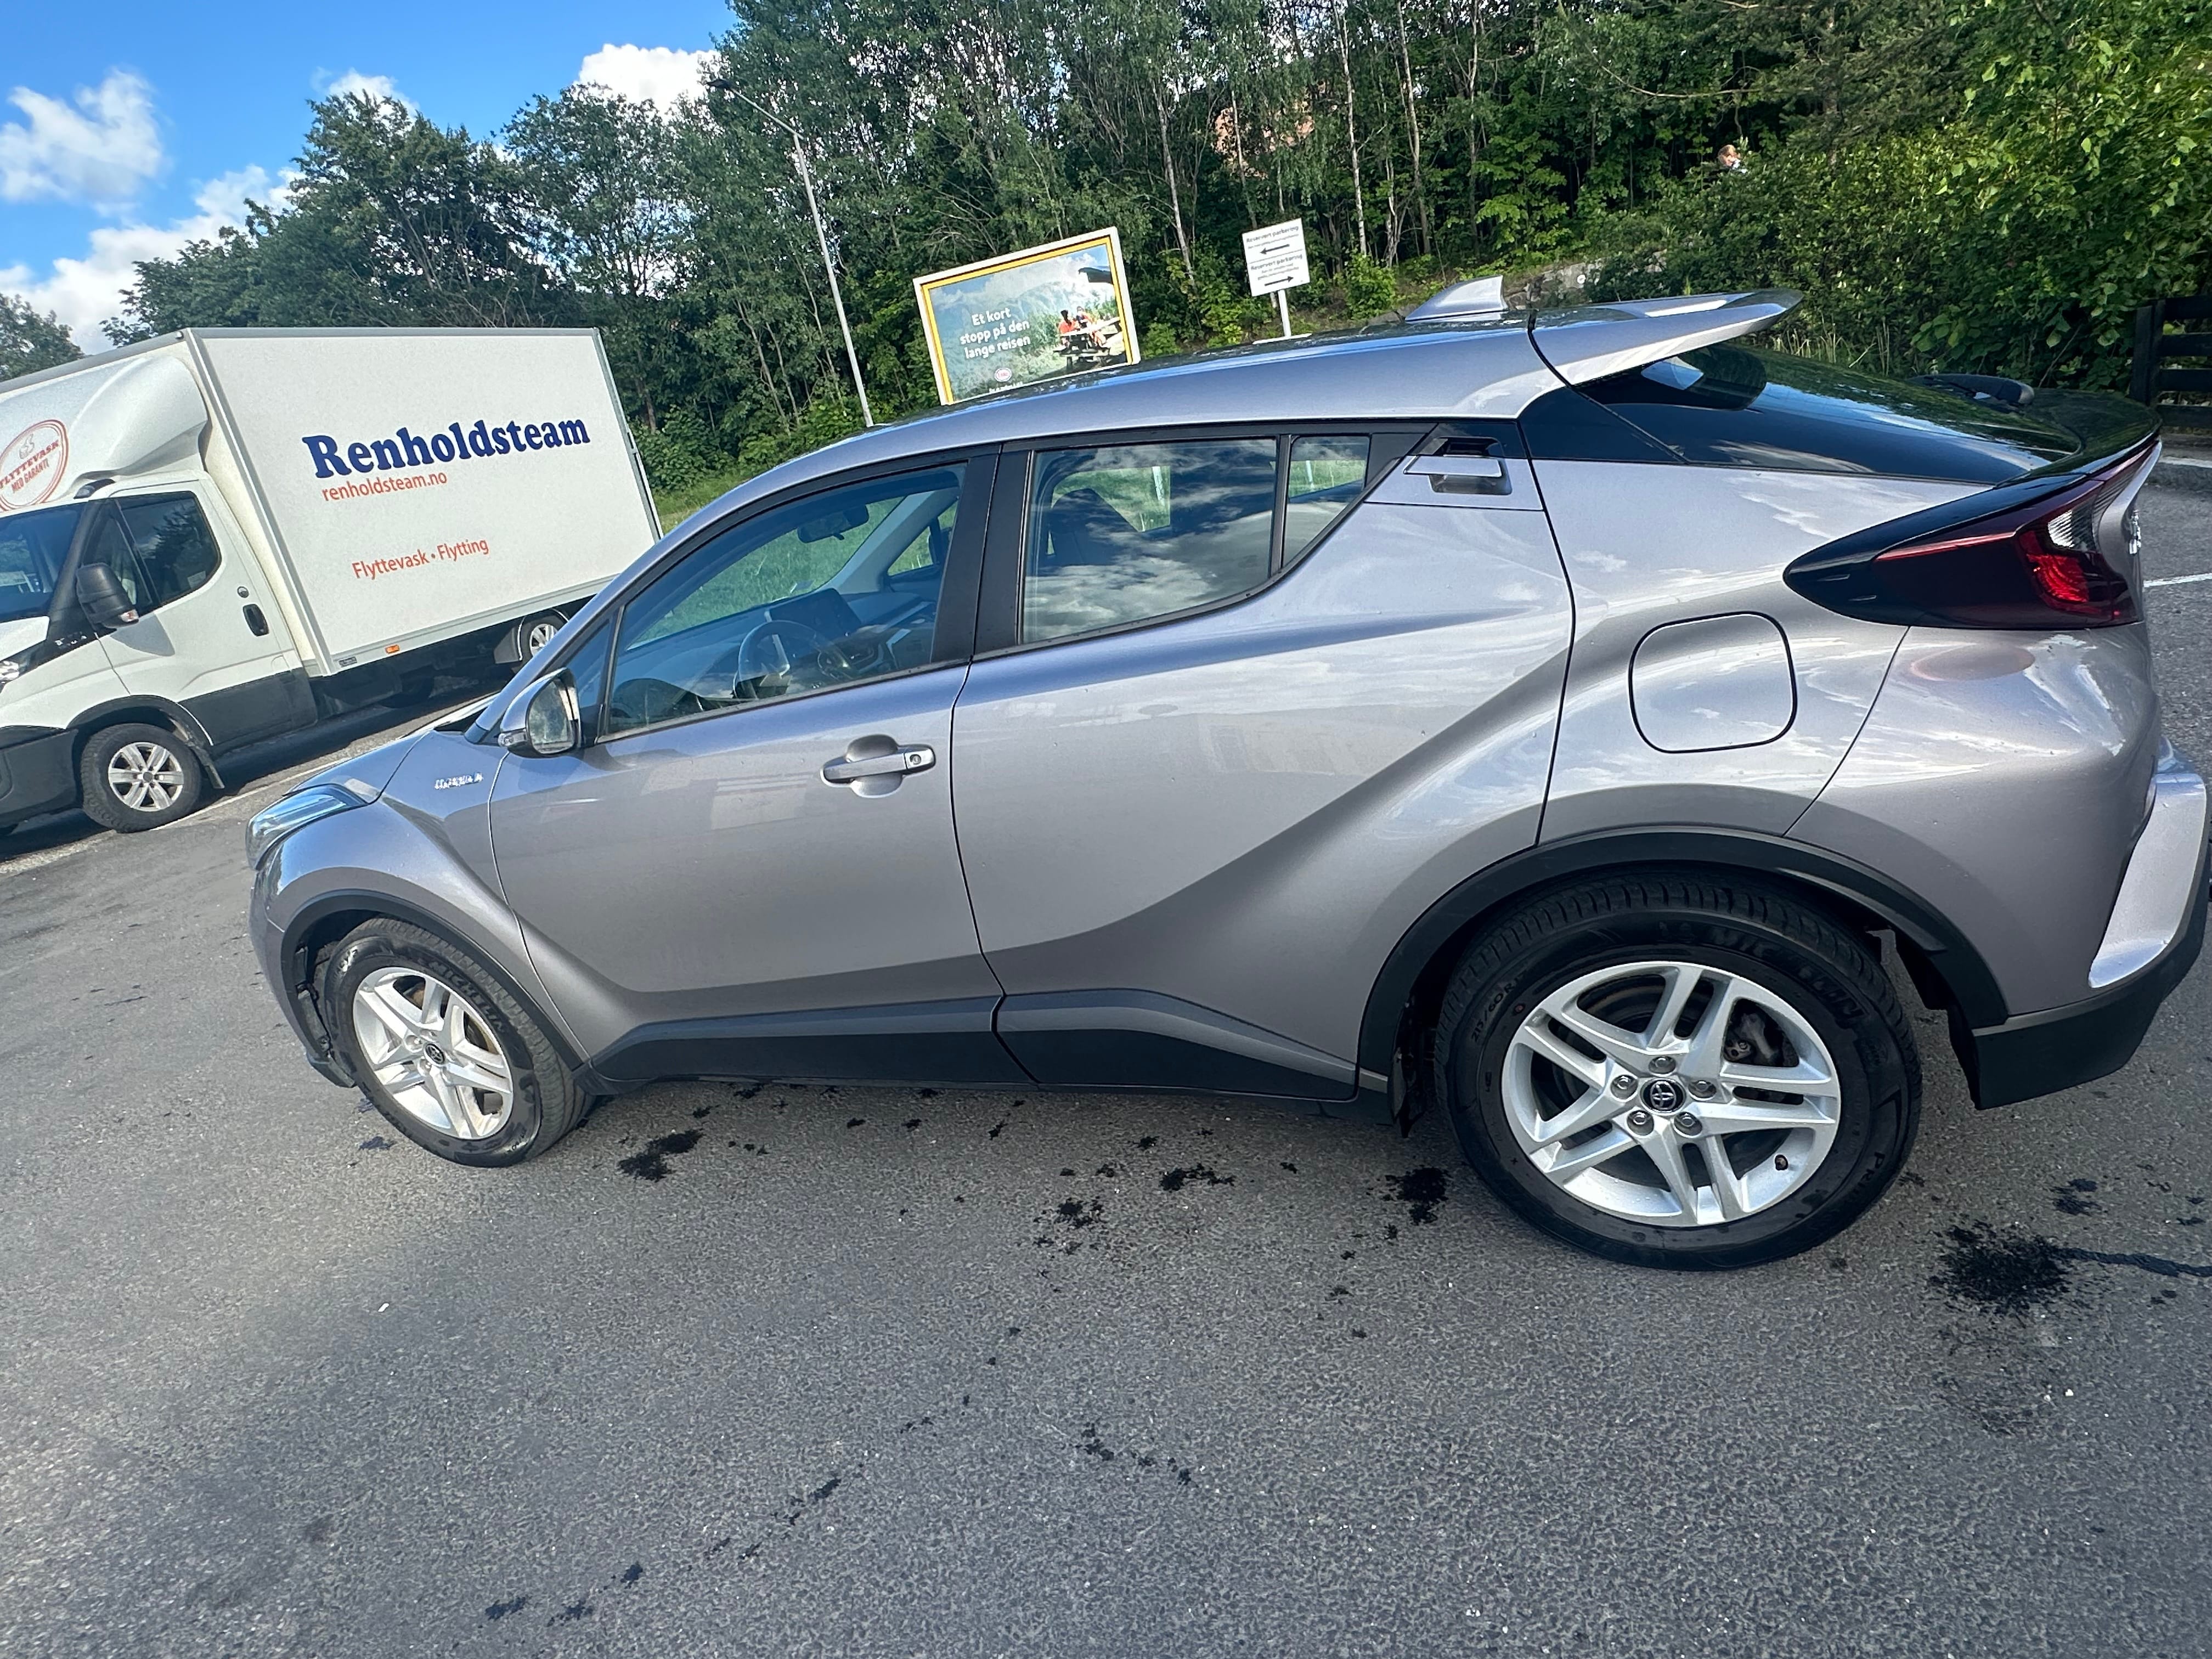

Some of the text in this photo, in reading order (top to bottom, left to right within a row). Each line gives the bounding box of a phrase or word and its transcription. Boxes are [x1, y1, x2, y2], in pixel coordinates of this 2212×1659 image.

[971, 307, 1012, 326] Et kort
[960, 320, 1030, 345] stopp på den
[964, 337, 1031, 359] lange reisen
[302, 419, 590, 478] Renholdsteam
[0, 439, 59, 489] FLYTTEVASK
[11, 476, 24, 493] MED
[321, 471, 448, 501] renholdsteam.no
[352, 539, 489, 580] Flyttevask Flytting
